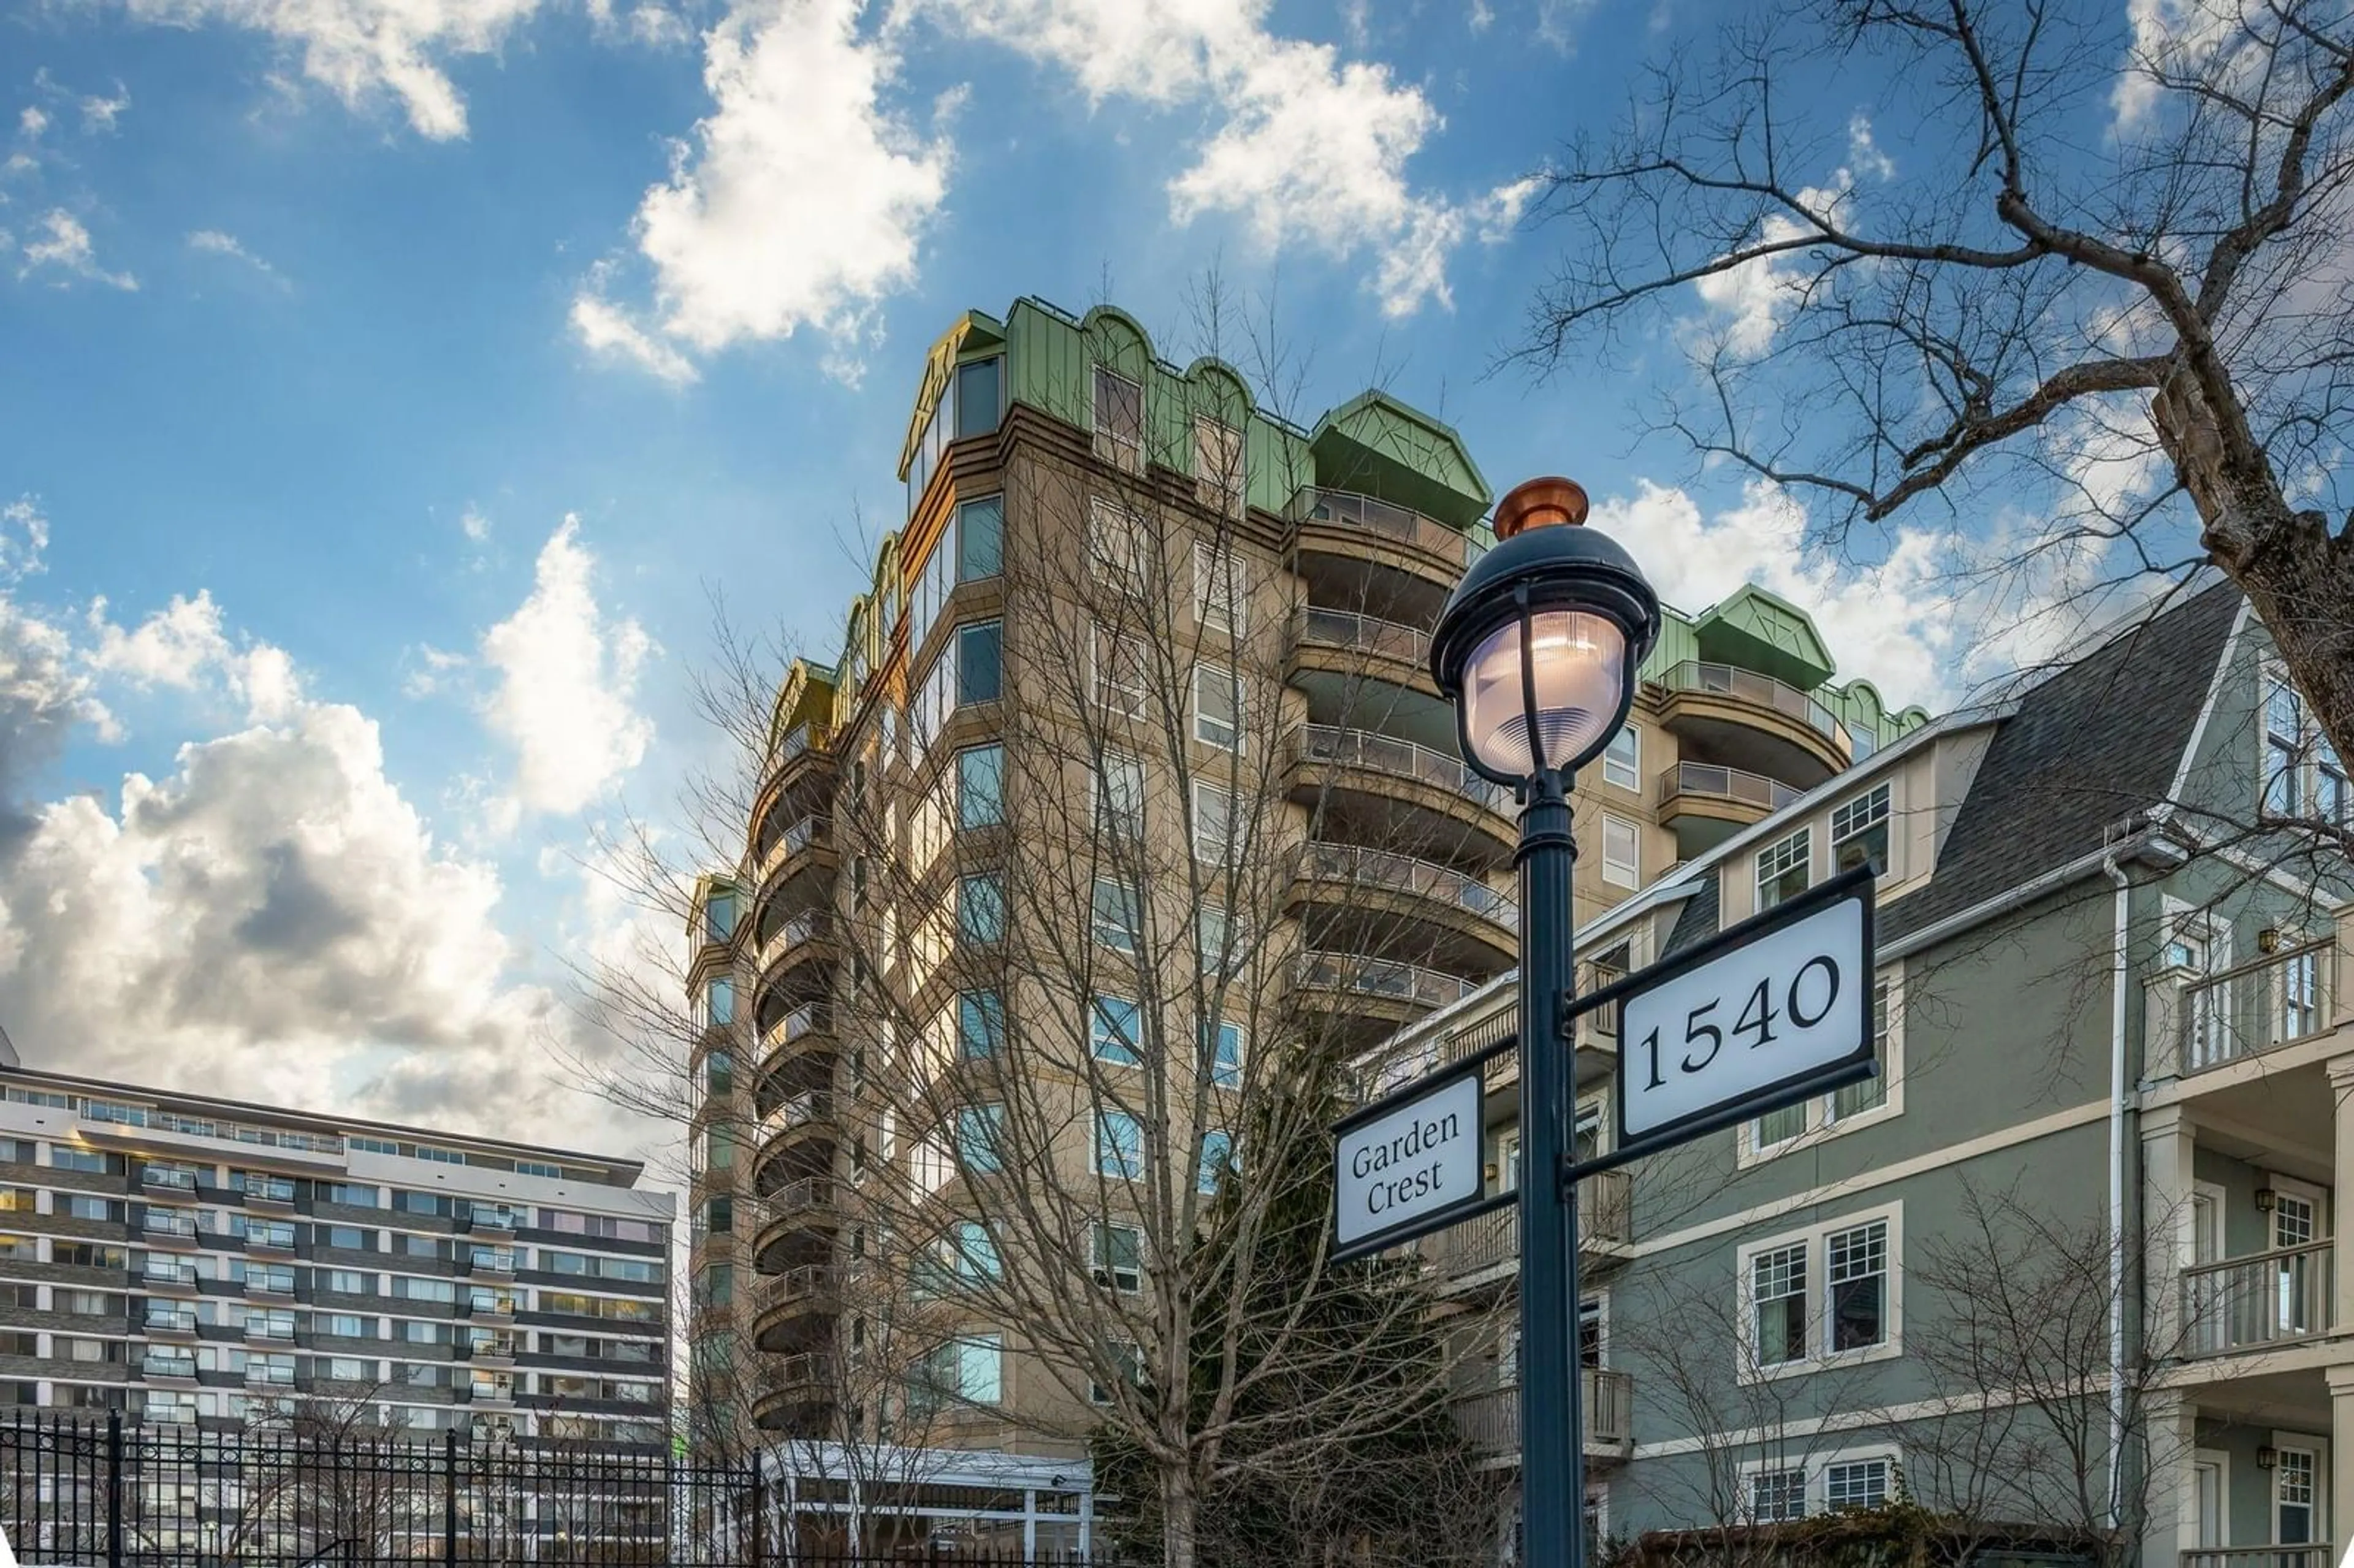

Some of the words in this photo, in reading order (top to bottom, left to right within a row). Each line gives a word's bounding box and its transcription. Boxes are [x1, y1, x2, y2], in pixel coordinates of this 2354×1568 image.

[1640, 954, 1840, 1092] 1540
[1352, 1112, 1460, 1179] Garden
[1368, 1160, 1443, 1215] Crest
